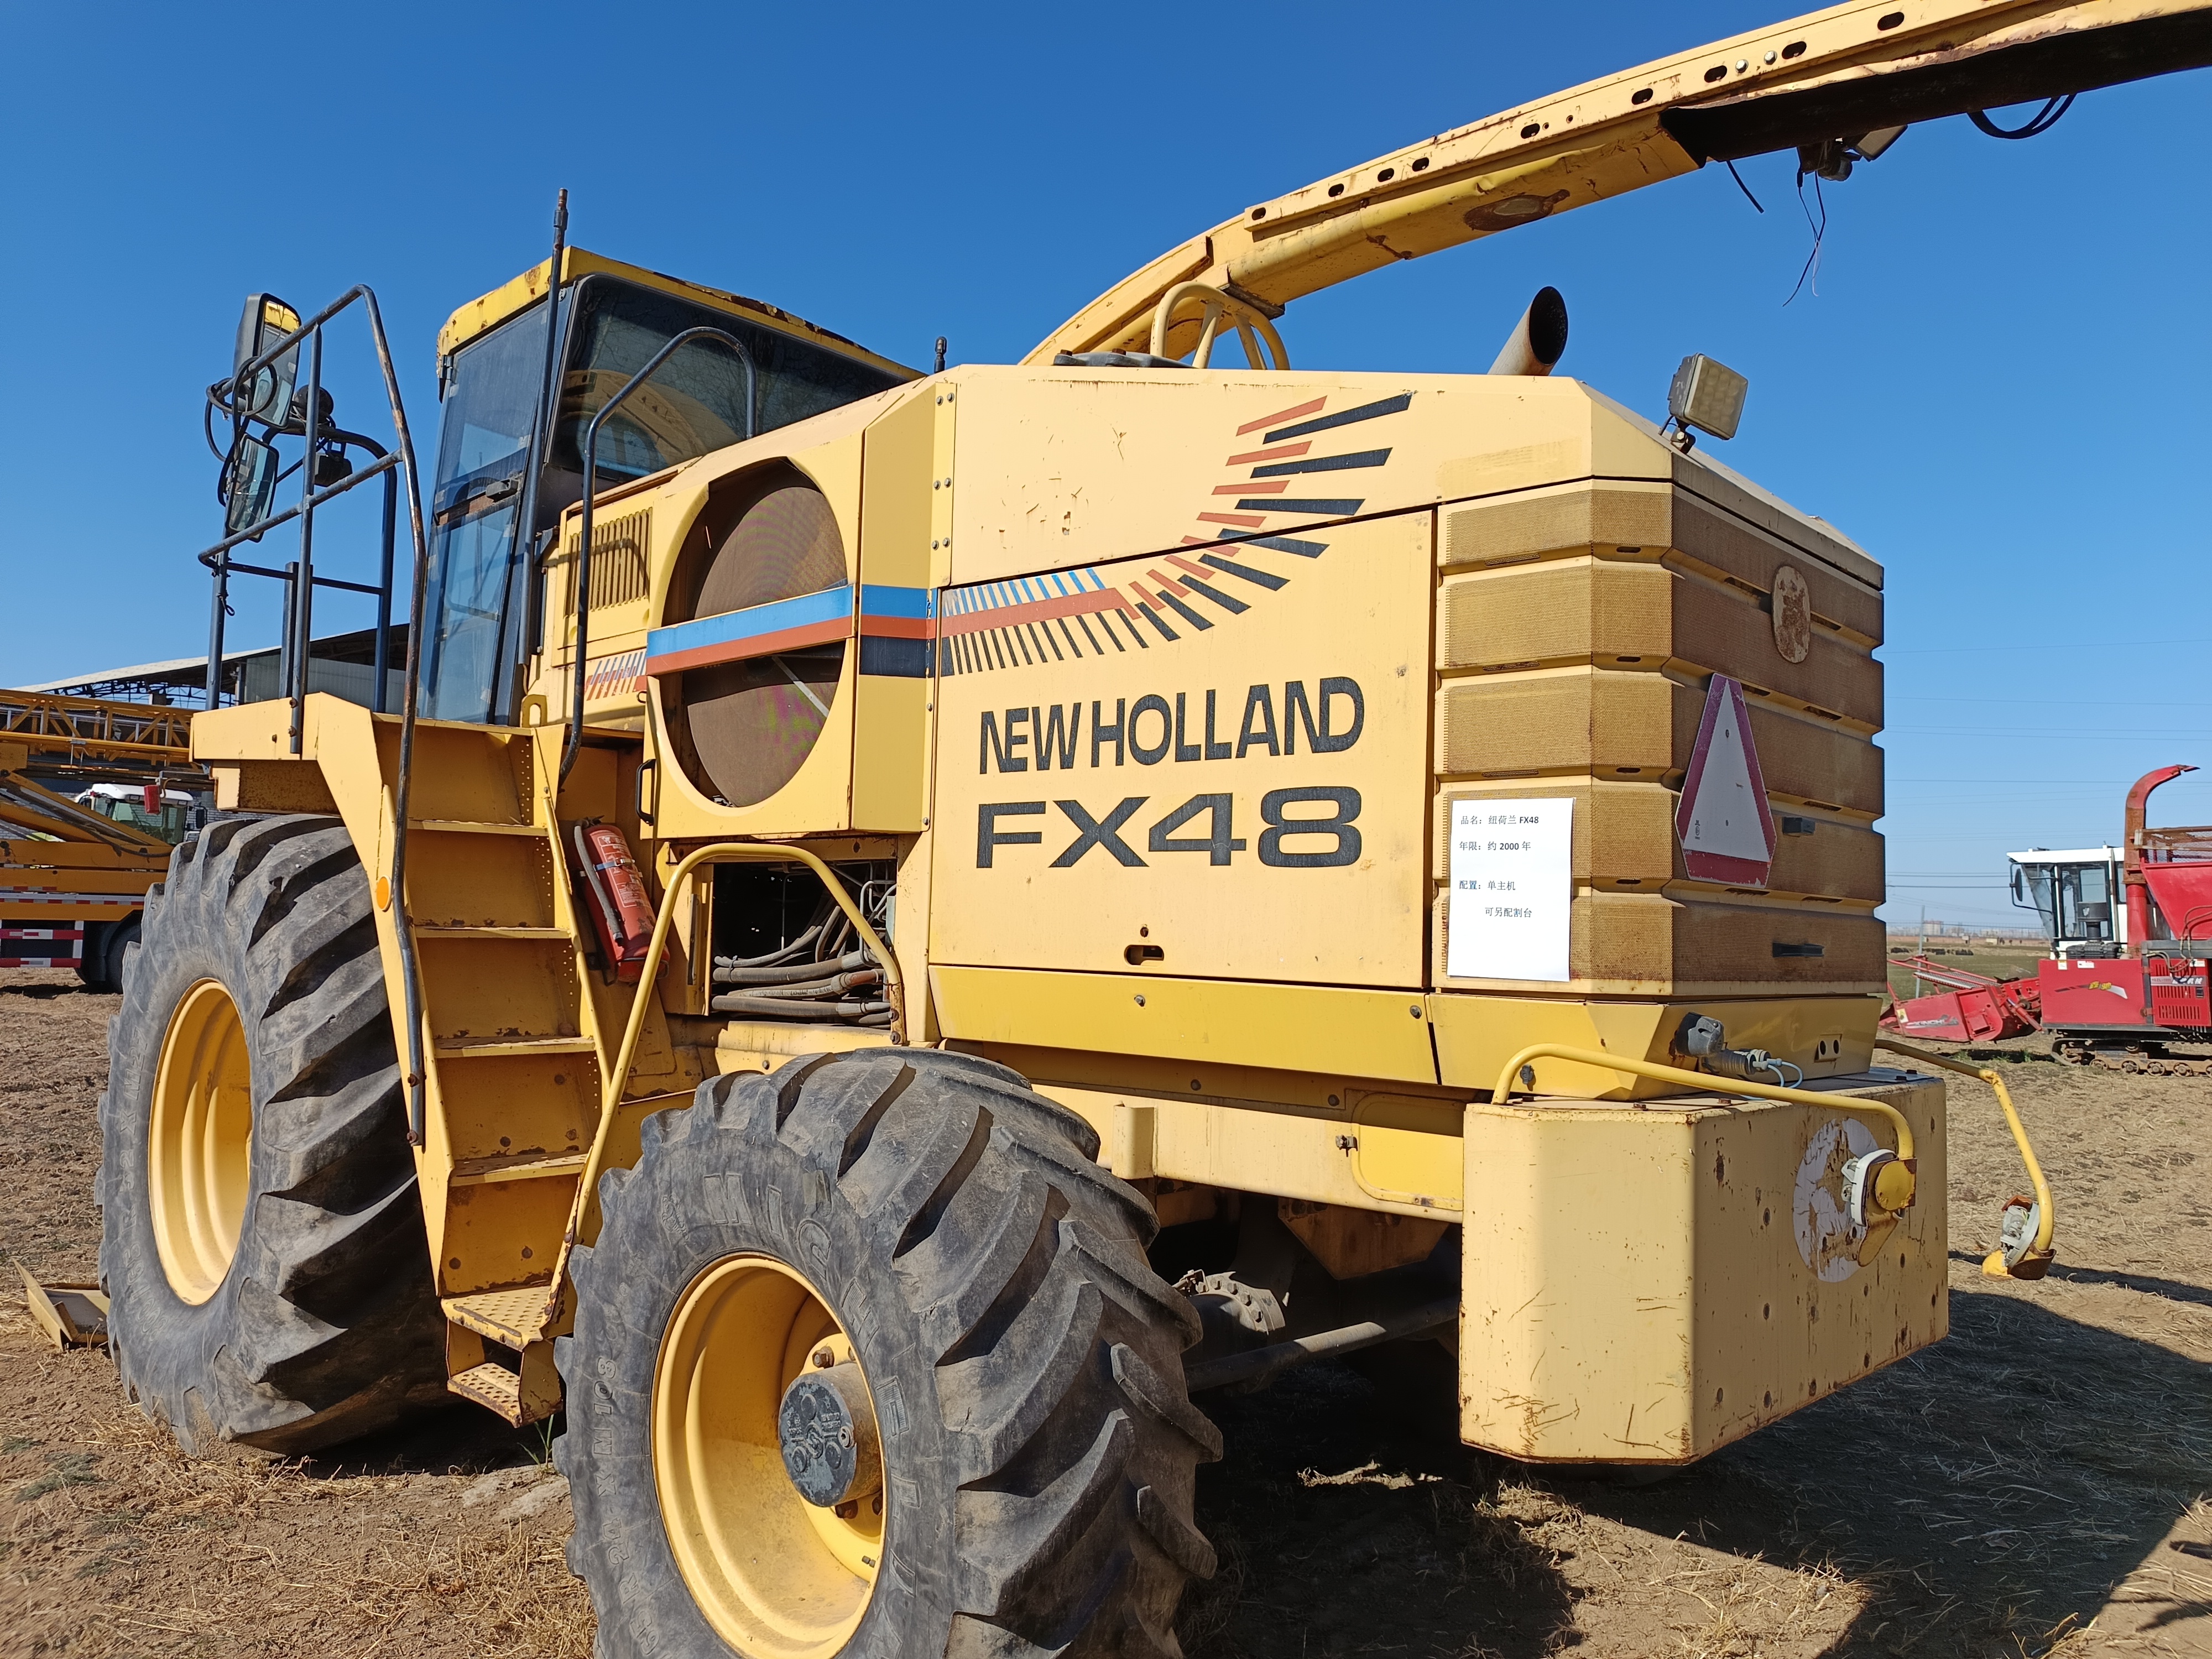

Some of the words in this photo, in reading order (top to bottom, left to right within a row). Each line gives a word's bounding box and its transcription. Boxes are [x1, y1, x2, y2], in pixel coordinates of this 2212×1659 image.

[980, 702, 1082, 775] NEW
[1091, 676, 1365, 768] HOLLAND
[976, 786, 1363, 869] FX48
[1519, 816, 1539, 824] FX48
[1485, 907, 1532, 918] 可另配割台
[596, 1473, 617, 1497] X
[602, 1517, 629, 1565] 24
[618, 1573, 641, 1605] R
